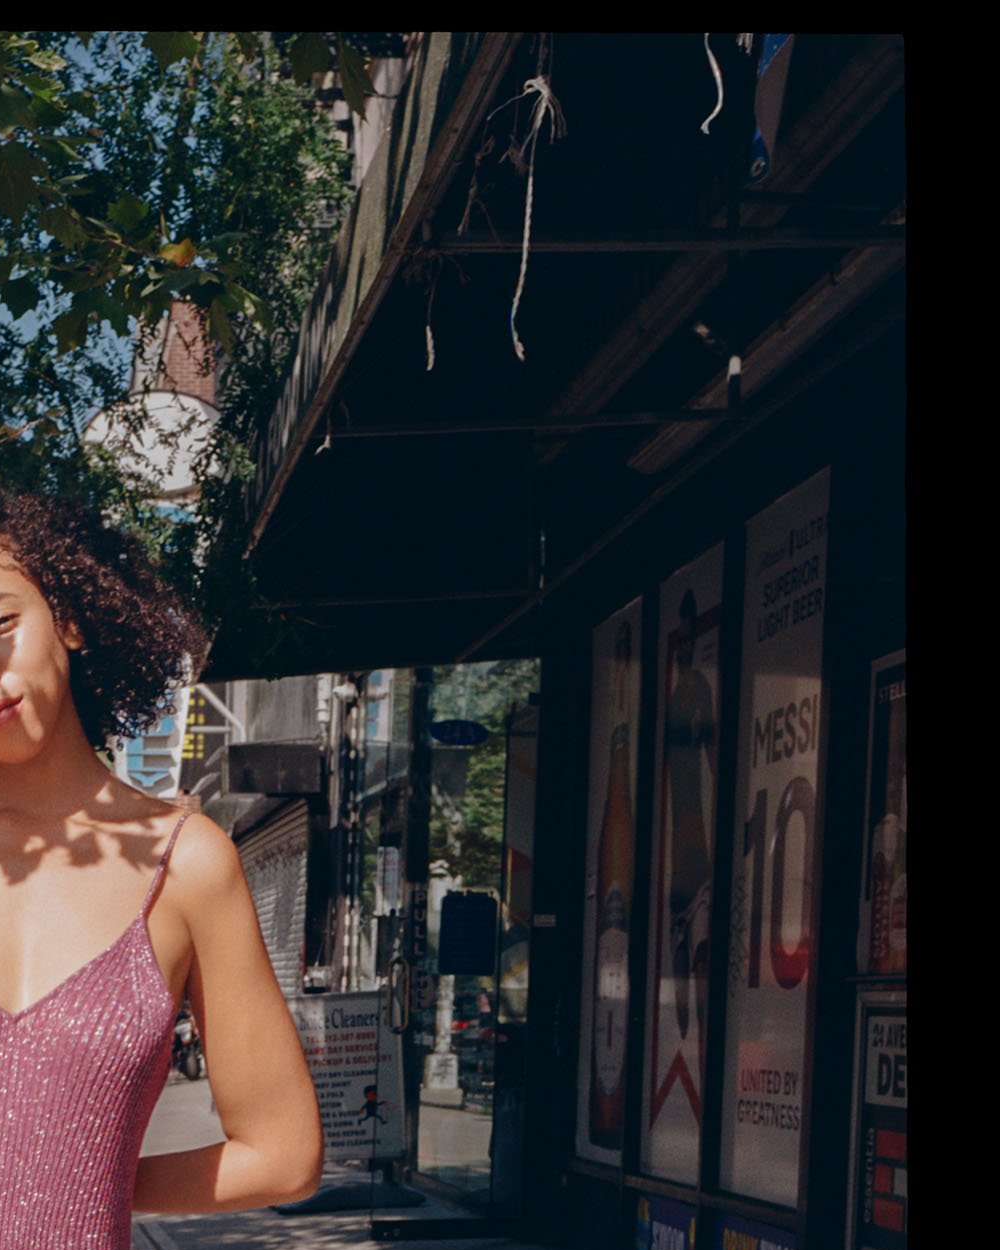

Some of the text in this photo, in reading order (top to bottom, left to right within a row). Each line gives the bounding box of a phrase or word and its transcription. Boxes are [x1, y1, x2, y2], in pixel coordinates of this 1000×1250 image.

[795, 517, 826, 549] ULTR
[763, 555, 819, 608] SUPERIOR
[757, 587, 822, 642] LIGHT BEER
[753, 694, 818, 768] MESSI
[744, 776, 816, 989] 10
[741, 1069, 799, 1096] UNITED BY
[738, 1099, 800, 1130] GREATNESS
